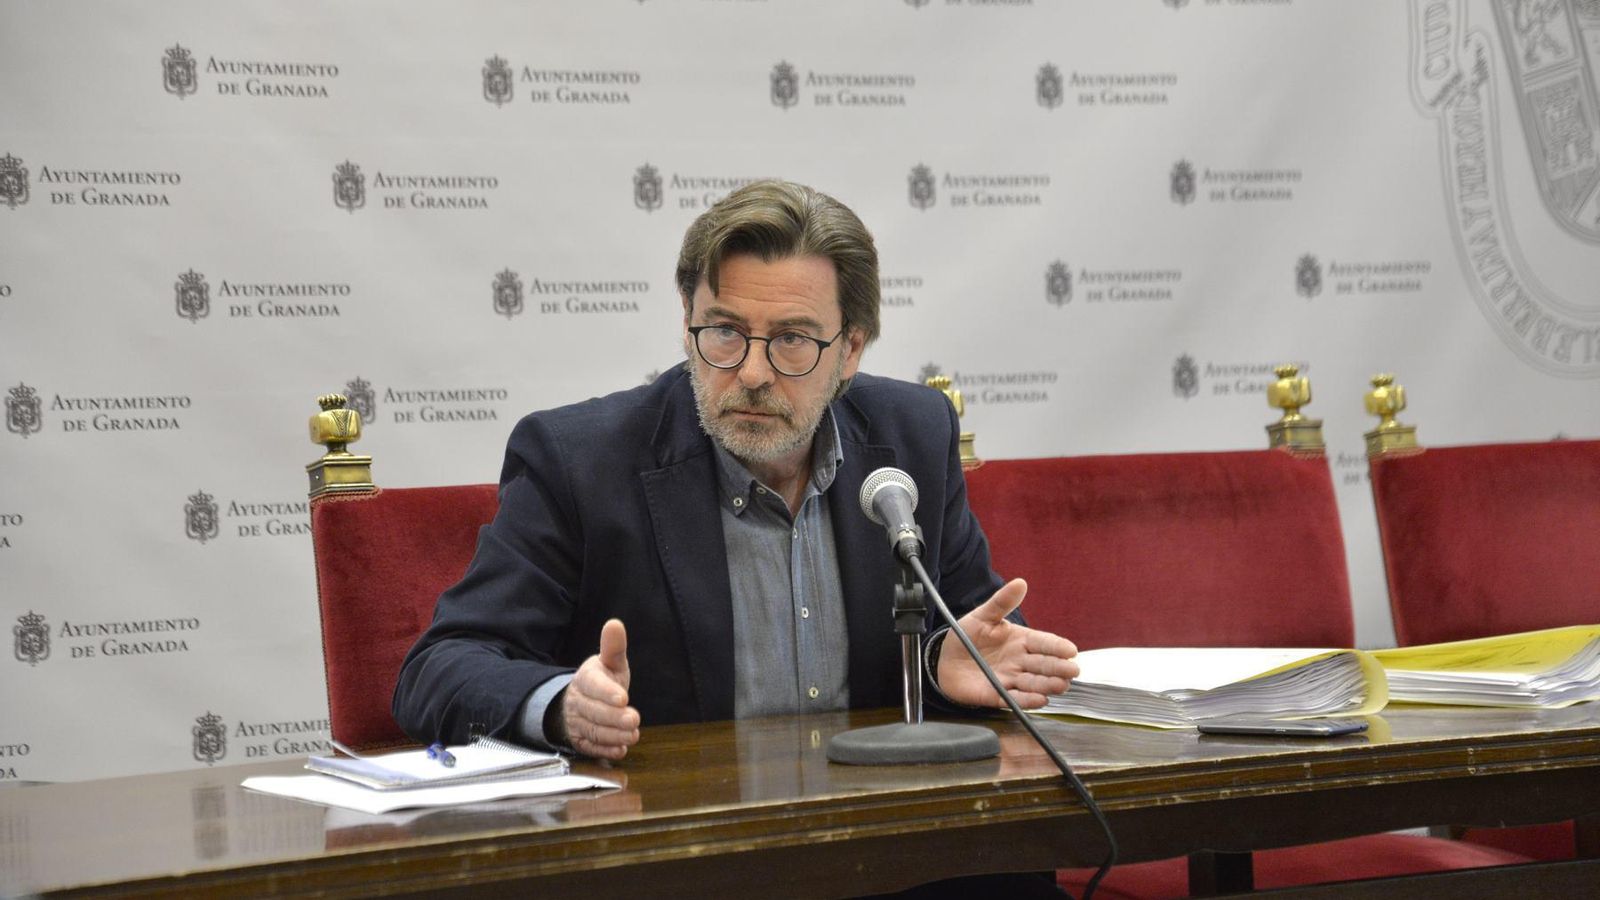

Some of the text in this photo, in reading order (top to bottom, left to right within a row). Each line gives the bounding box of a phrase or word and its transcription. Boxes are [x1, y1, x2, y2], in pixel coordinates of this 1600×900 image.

[206, 56, 339, 79] AYUNTAMIENTO
[520, 66, 640, 85] AYUNTAMIENTO
[217, 79, 329, 98] DE GRANADA
[531, 86, 631, 105] DE GRANADA
[38, 165, 181, 186] AYUNTAMIENTO
[373, 172, 499, 190] AYUNTAMIENTO
[50, 188, 170, 207] DE GRANADA
[383, 191, 489, 210] DE GRANADA
[219, 280, 351, 298] AYUNTAMIENTO
[530, 278, 649, 295] AYUNTAMIENTO
[229, 301, 340, 318] DE GRANADA
[540, 297, 640, 314] DE GRANADA
[51, 395, 192, 412] AYUNTAMIENTO
[383, 388, 507, 404] AYUNTAMIENTO
[63, 414, 180, 432] DE GRANADA
[394, 406, 498, 424] DE GRANADA
[237, 523, 262, 538] DE
[59, 618, 200, 639] AYUNTAMIENTO
[71, 639, 189, 660] DE GRANADA
[245, 743, 269, 758] DE
